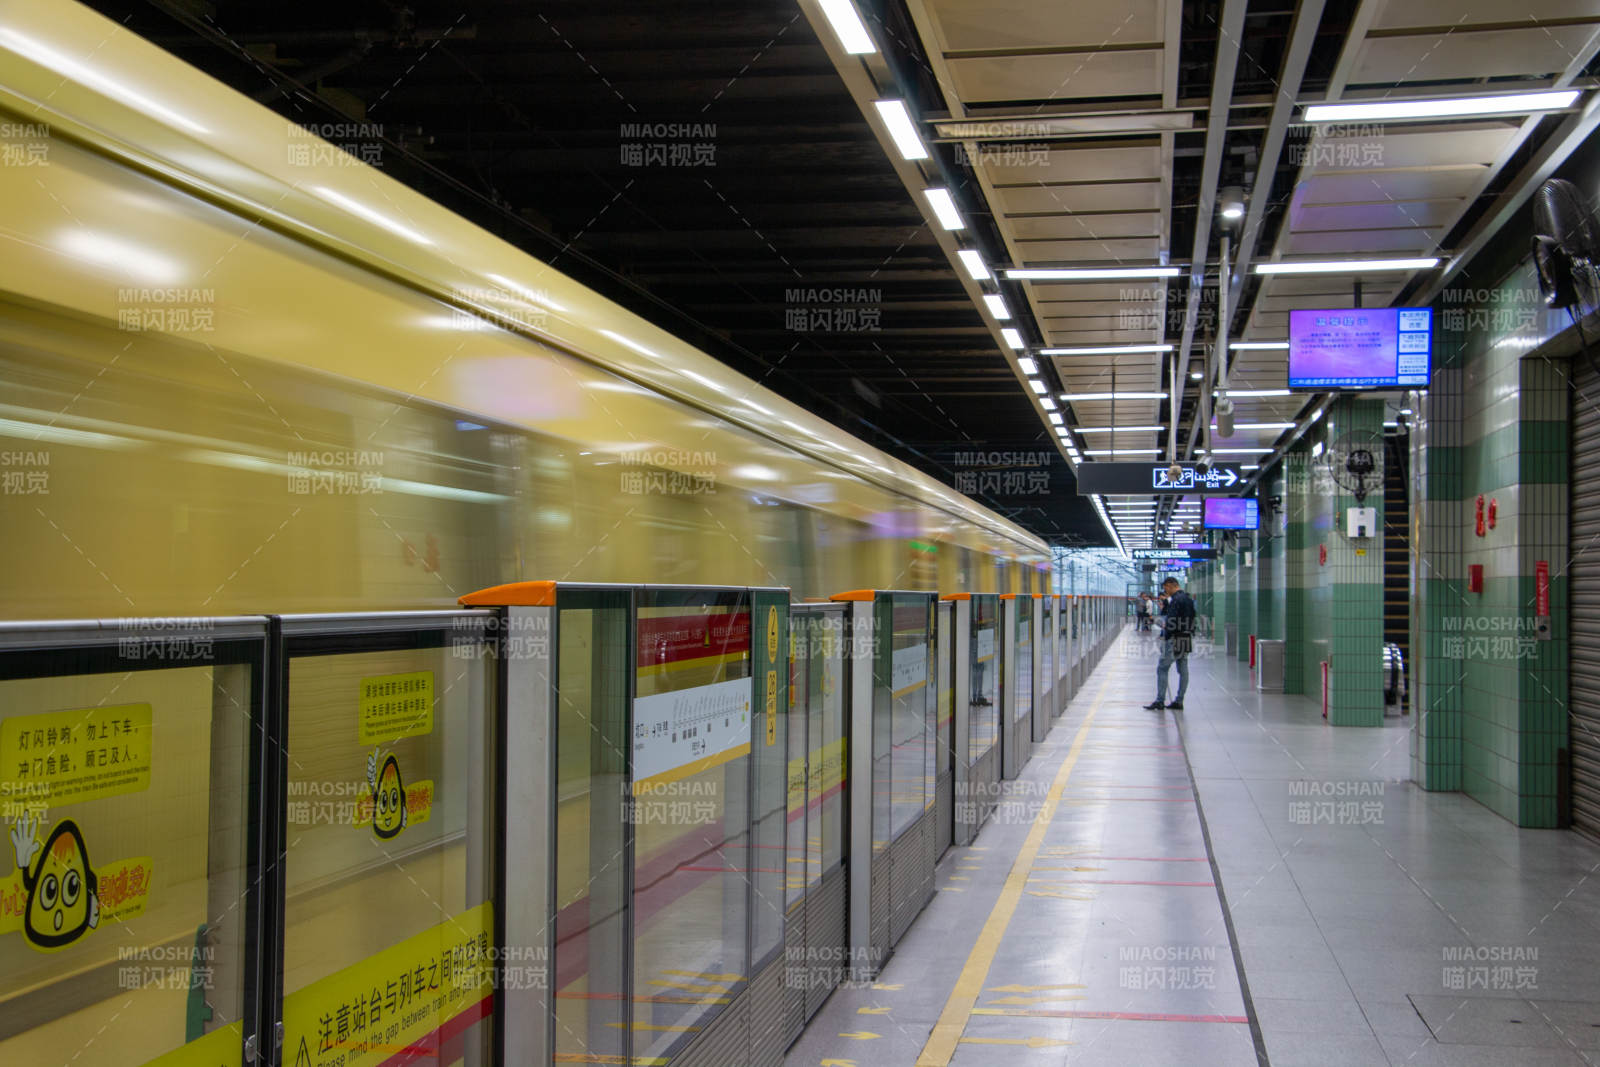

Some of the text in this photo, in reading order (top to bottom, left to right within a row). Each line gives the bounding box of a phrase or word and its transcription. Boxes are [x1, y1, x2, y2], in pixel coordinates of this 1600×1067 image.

[317, 930, 488, 1057] 注意站台与列车之间的空隙
[349, 1036, 368, 1063] mind
[371, 1031, 383, 1050] the
[385, 1022, 399, 1045] gap
[402, 1003, 430, 1030] between
[432, 993, 447, 1013] train
